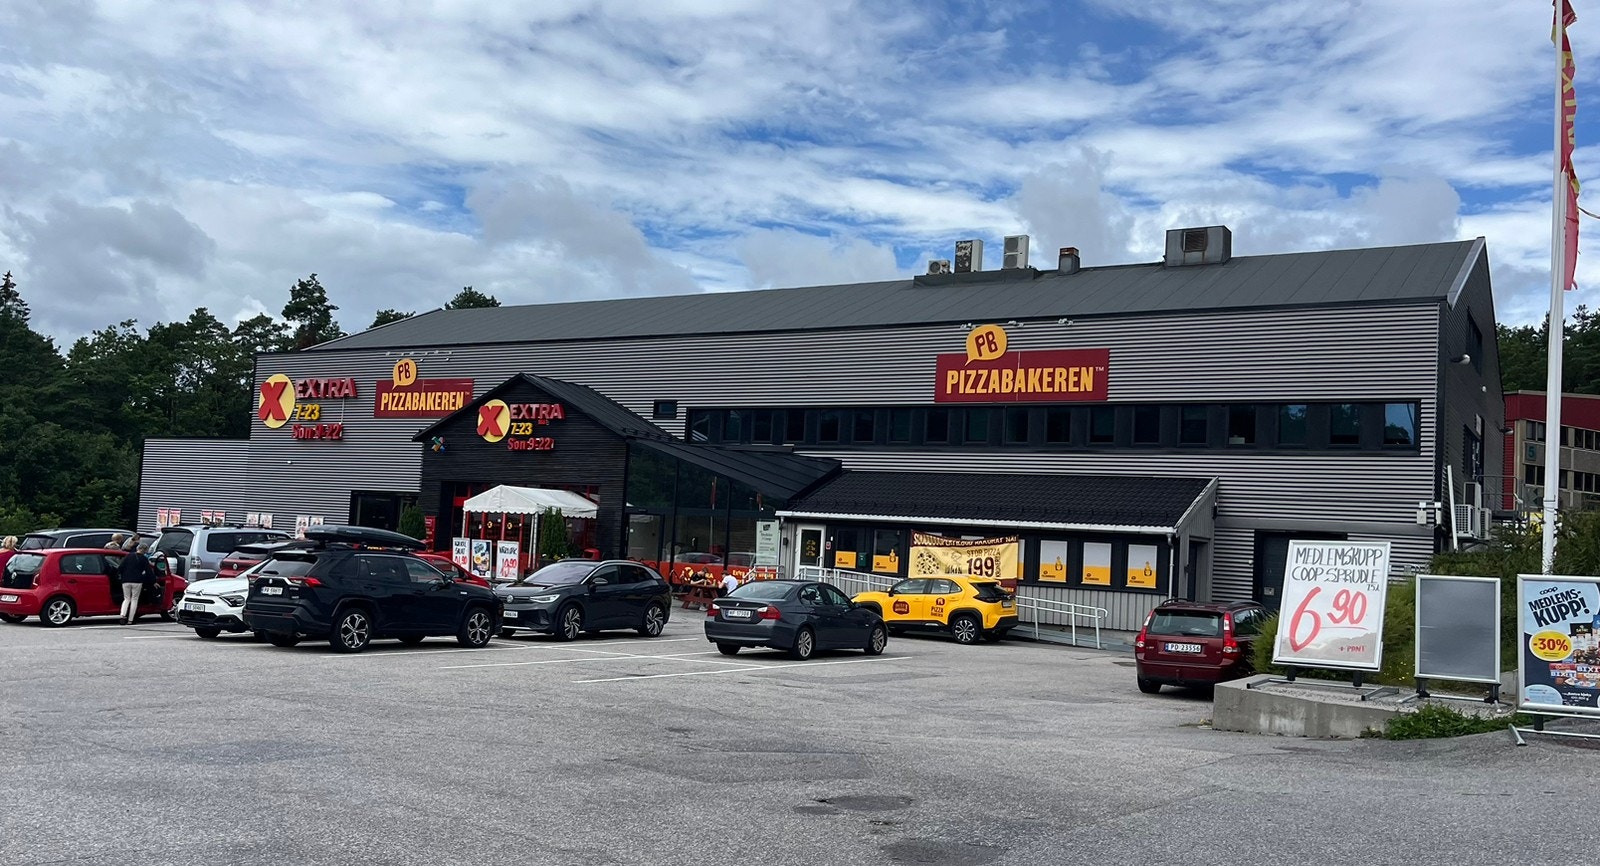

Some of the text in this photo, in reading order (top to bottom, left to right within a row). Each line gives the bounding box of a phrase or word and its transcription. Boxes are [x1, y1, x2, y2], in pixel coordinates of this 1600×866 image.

[974, 330, 998, 357] PB
[398, 361, 410, 381] PB
[946, 366, 1094, 394] PIZZABAKEREN
[295, 377, 358, 399] EXTRA
[380, 390, 464, 411] PIZZABAKEREN
[295, 403, 321, 421] 7-23
[509, 403, 564, 419] EXTRA
[510, 422, 533, 435] 7-23
[1528, 446, 1536, 458] 5
[984, 547, 1001, 557] PIZZA
[966, 556, 995, 578] 199
[1292, 566, 1380, 584] COOP SPRUDLE
[1528, 588, 1581, 612] MEDLEMS-
[1289, 586, 1367, 653] 6 90
[1532, 597, 1590, 628] KUPP!
[1180, 644, 1201, 652] 23556
[1533, 637, 1569, 652] -30%
